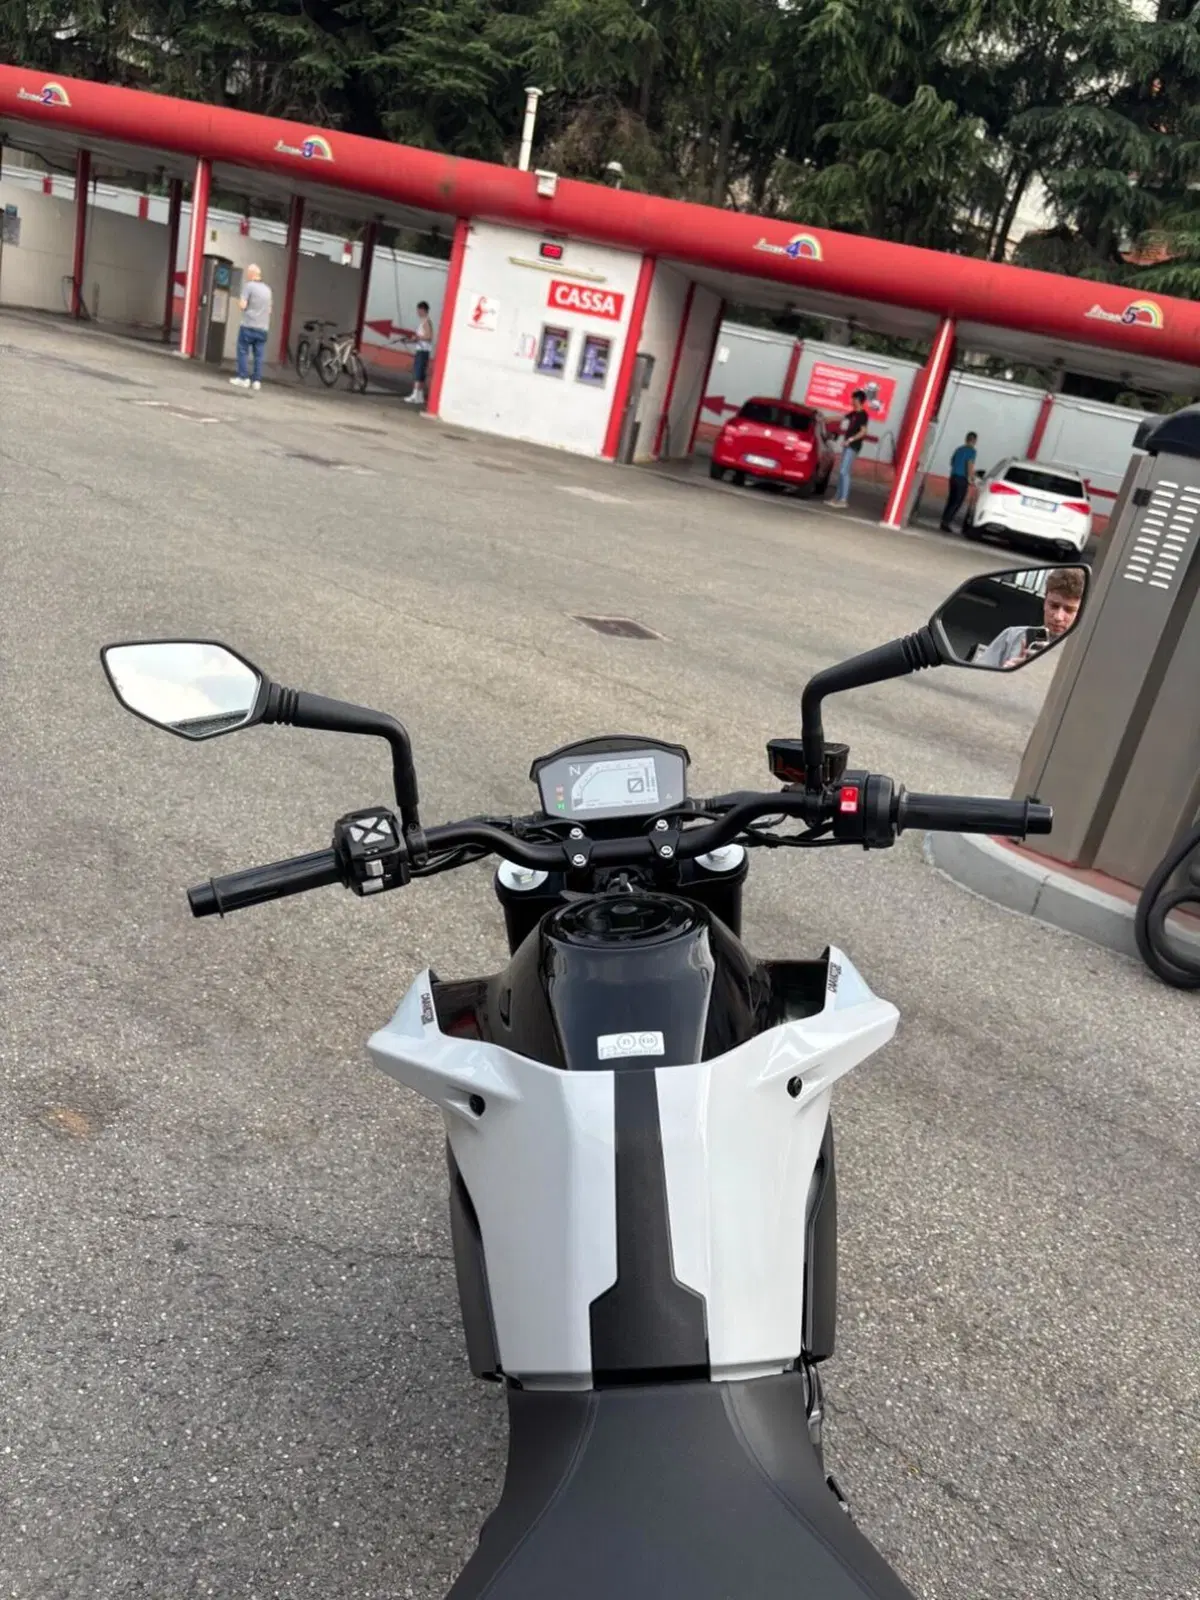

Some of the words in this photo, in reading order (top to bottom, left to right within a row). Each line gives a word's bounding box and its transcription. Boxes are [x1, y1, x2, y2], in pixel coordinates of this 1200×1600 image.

[42, 88, 53, 105] 2
[303, 142, 314, 158] 3
[787, 240, 801, 257] 4
[555, 285, 616, 316] CASSA
[1122, 306, 1139, 324] 5
[569, 764, 581, 777] N
